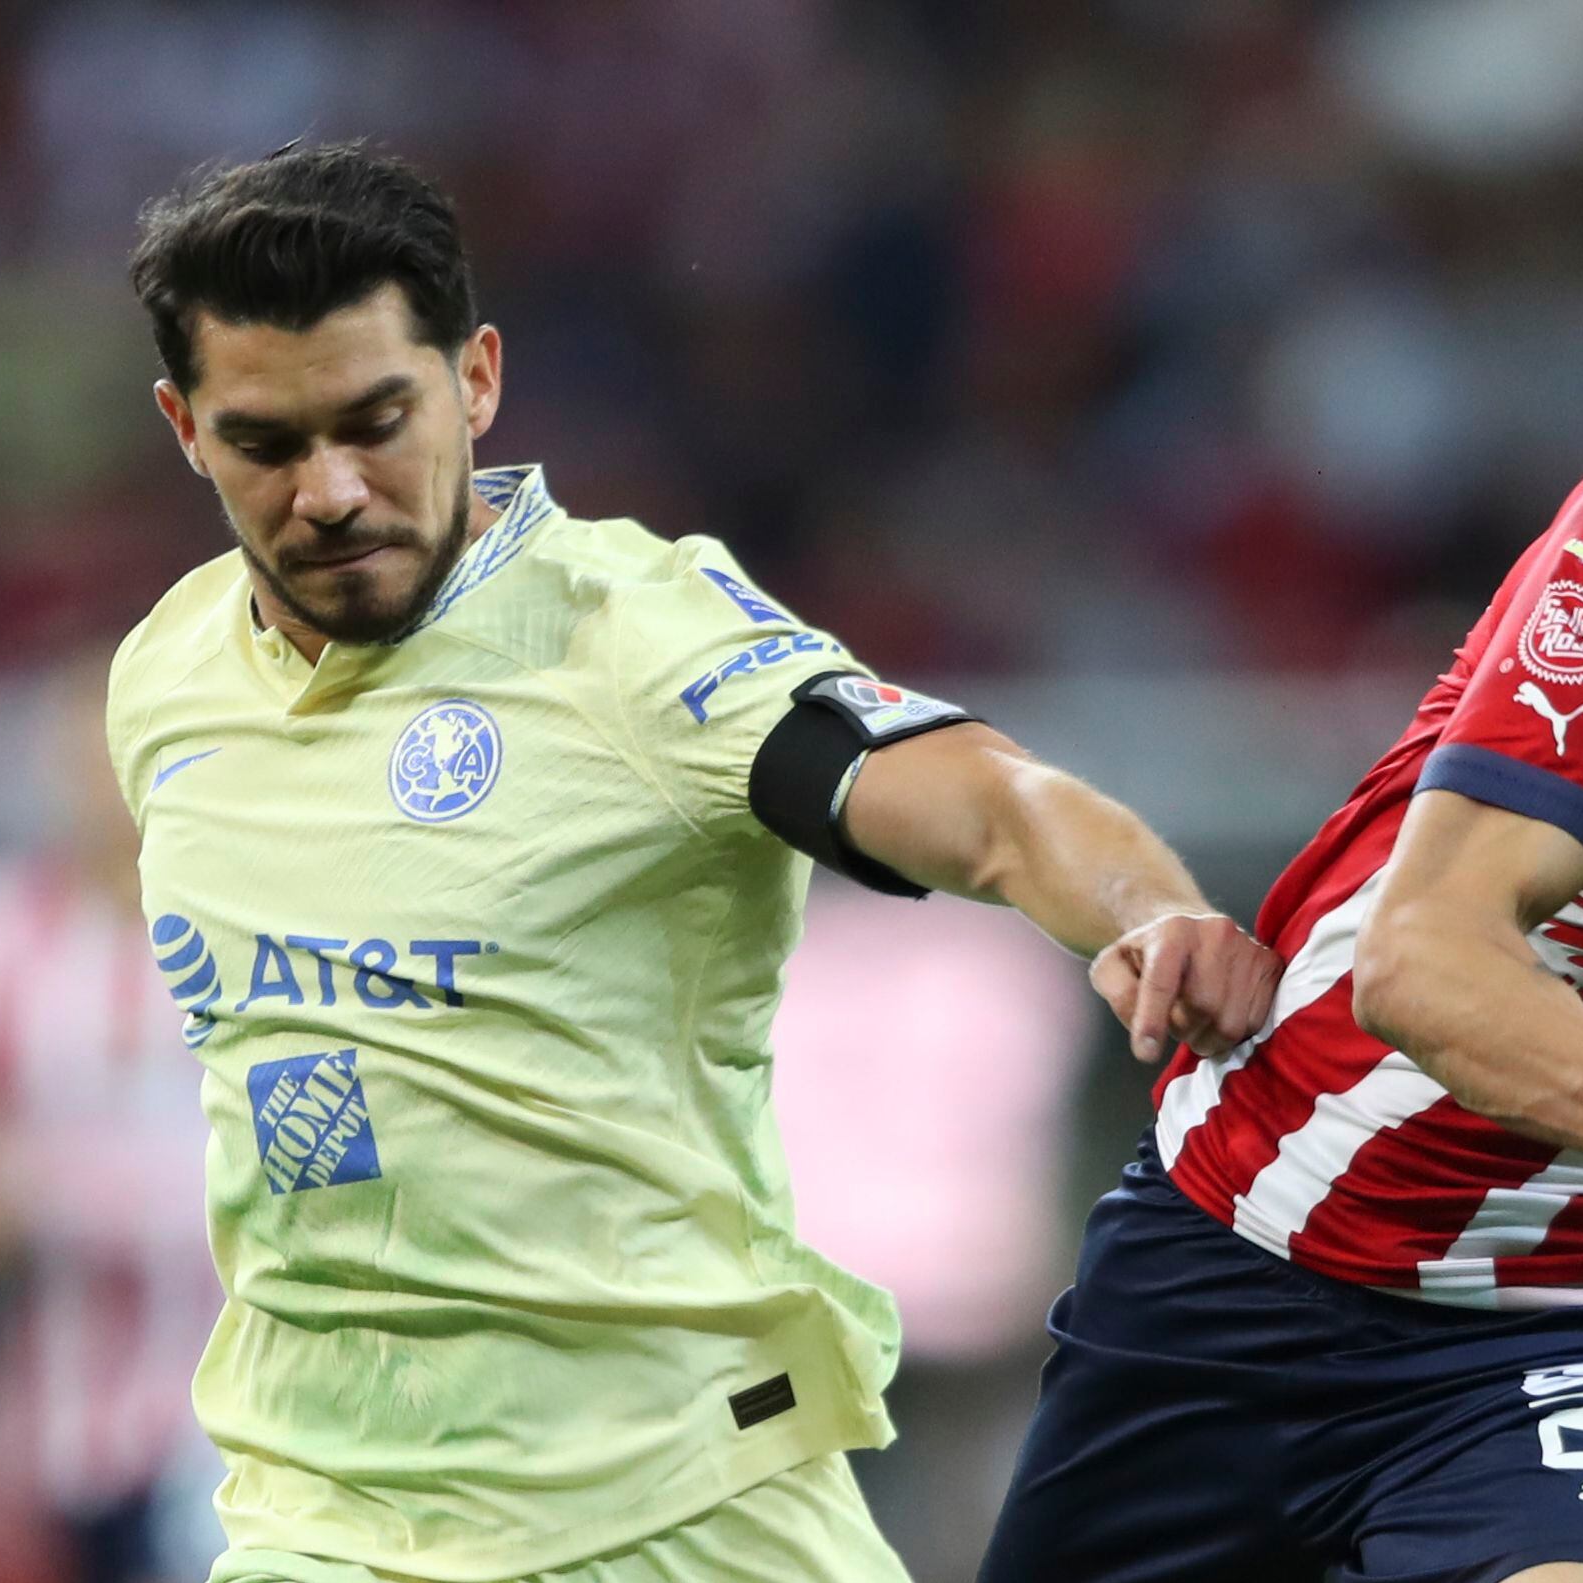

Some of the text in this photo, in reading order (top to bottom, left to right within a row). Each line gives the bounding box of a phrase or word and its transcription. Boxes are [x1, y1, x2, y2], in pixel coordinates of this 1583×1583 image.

[679, 632, 841, 726] FREE
[235, 933, 481, 1013] AT&T
[260, 1070, 301, 1128] THE
[263, 1050, 358, 1194] HOME
[305, 1095, 369, 1188] DEPOT
